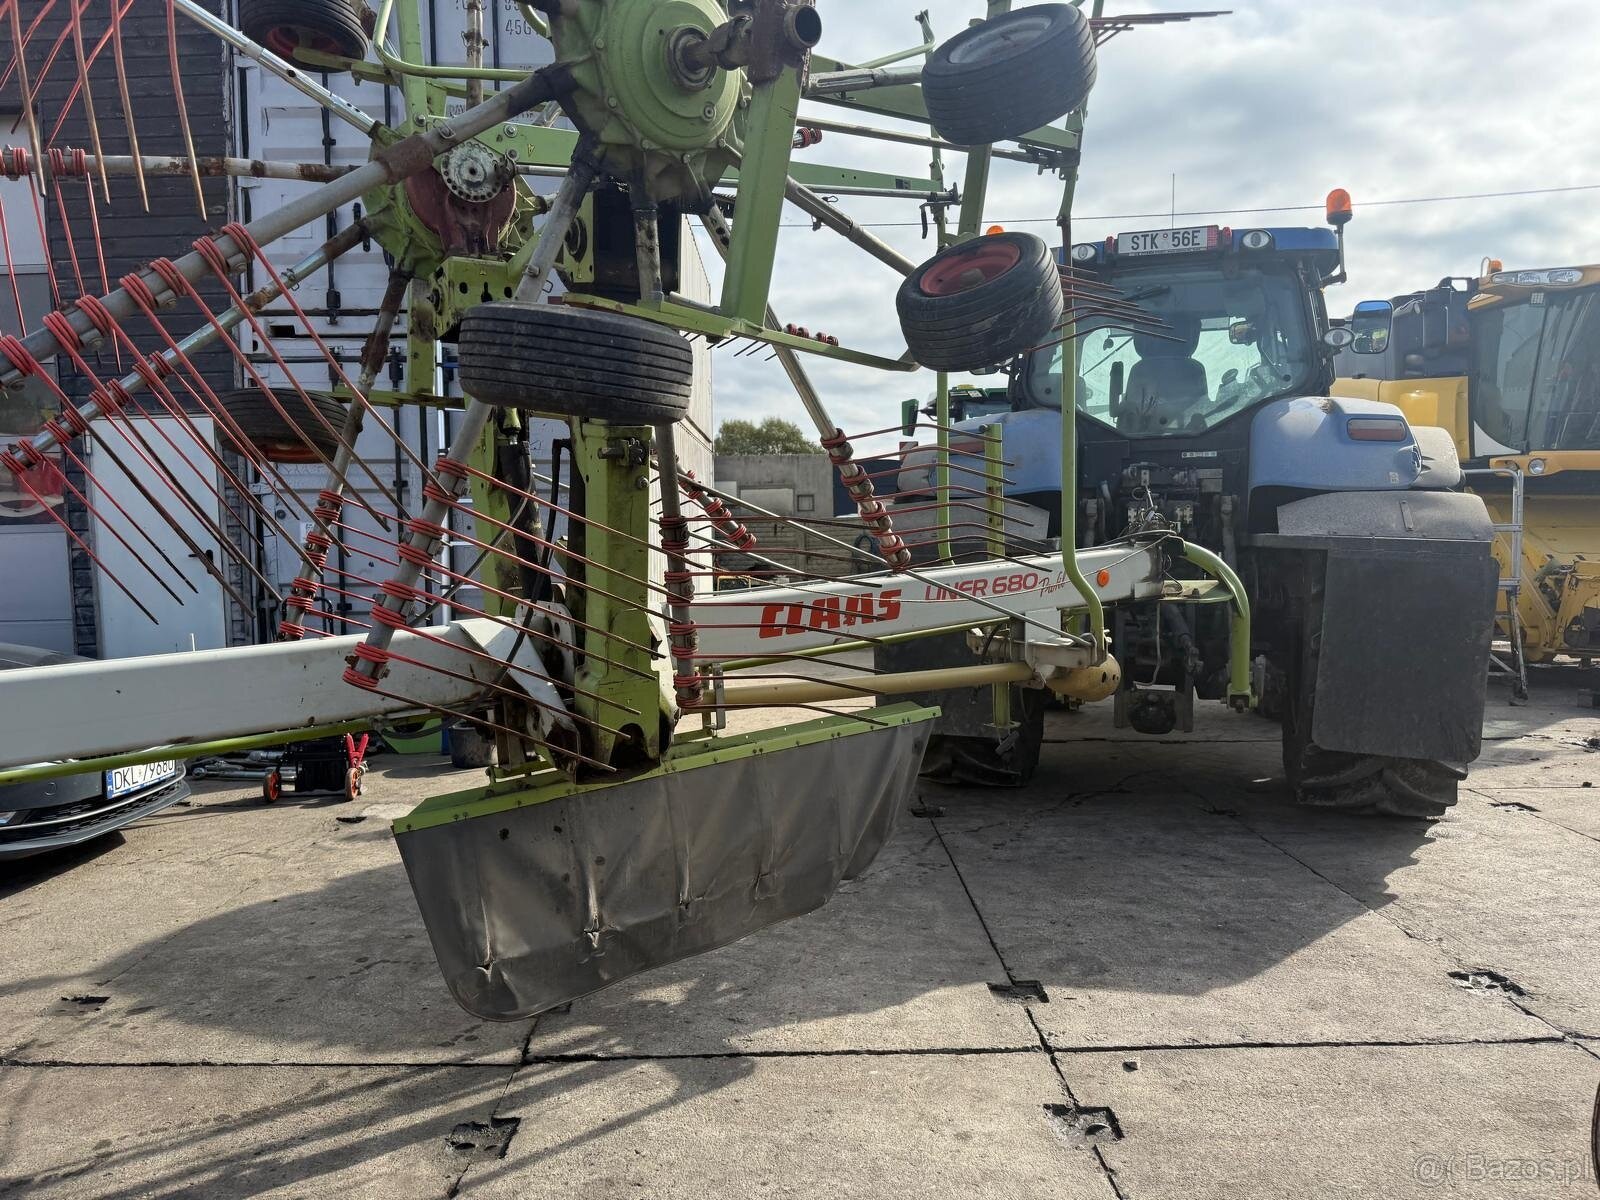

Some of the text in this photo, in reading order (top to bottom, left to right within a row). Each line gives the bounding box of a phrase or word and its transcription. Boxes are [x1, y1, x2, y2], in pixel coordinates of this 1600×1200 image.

[1131, 230, 1201, 251] STK 56E
[992, 572, 1038, 594] 680
[759, 589, 902, 638] CLAAS
[114, 767, 138, 790] DKL
